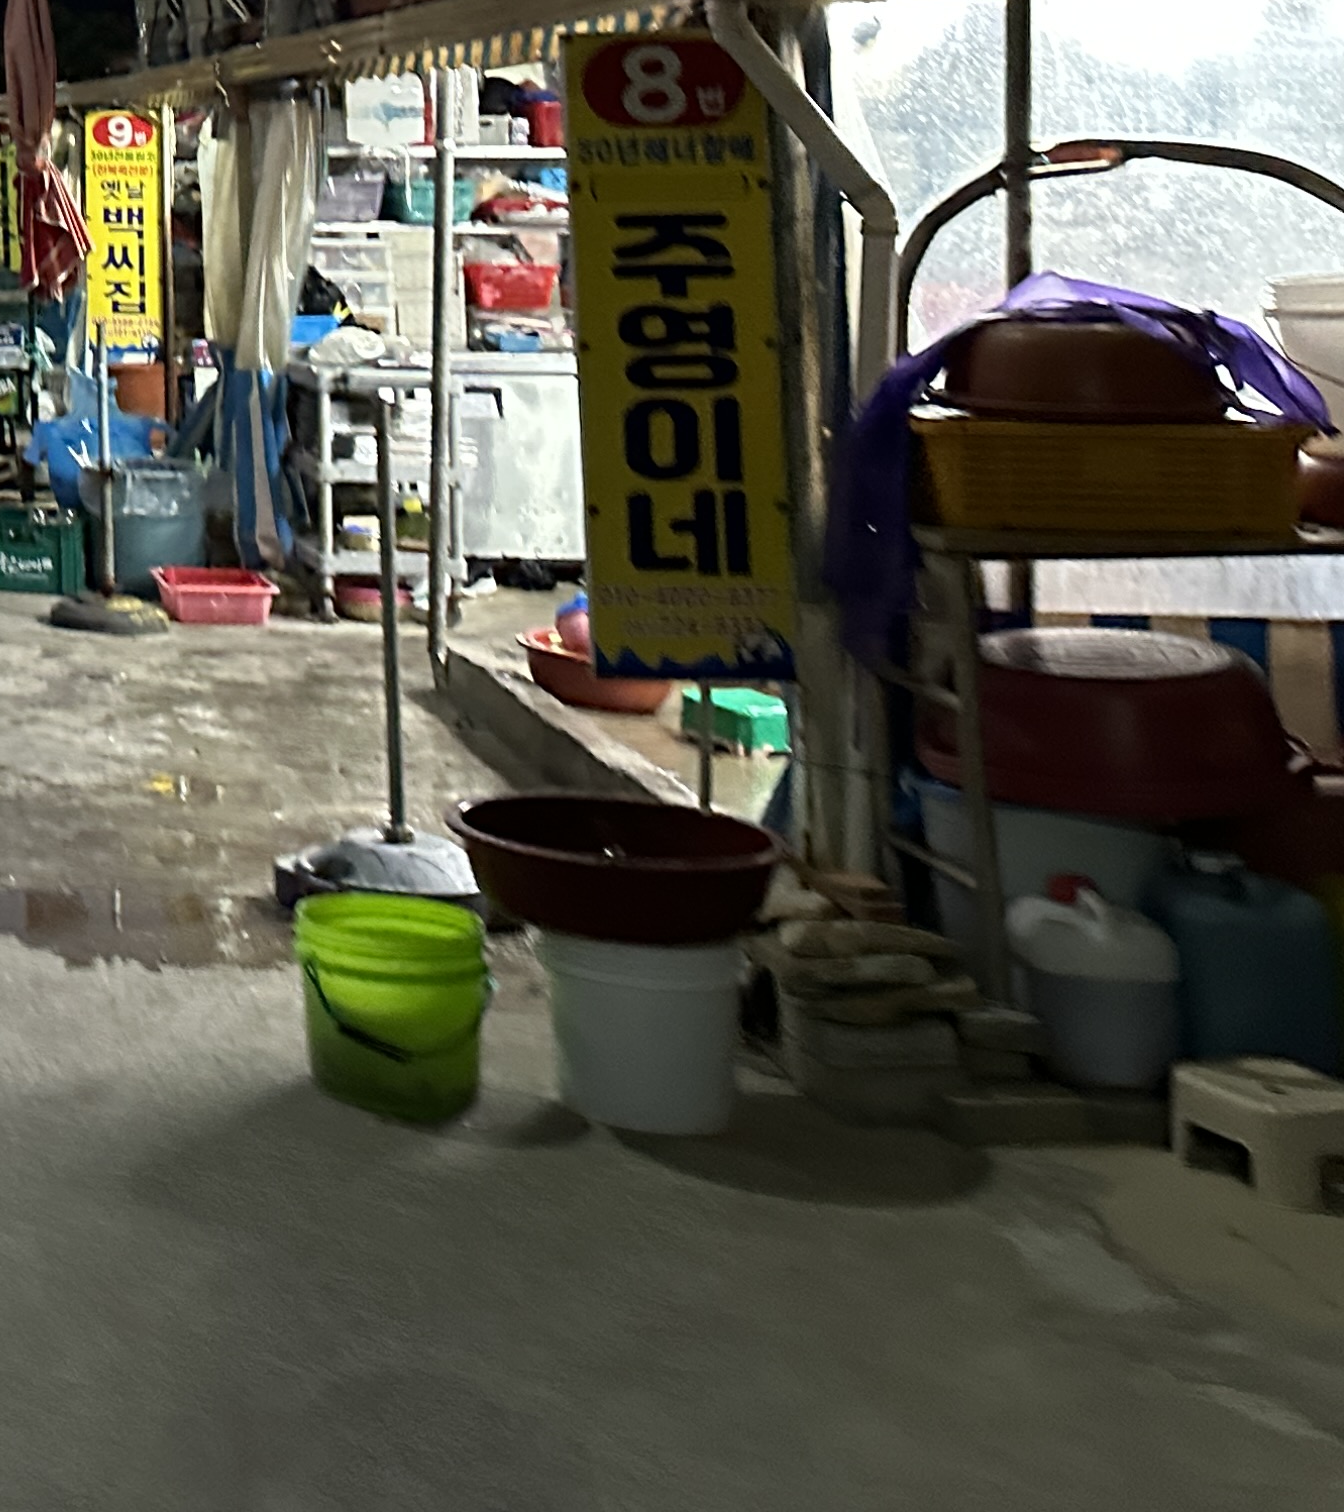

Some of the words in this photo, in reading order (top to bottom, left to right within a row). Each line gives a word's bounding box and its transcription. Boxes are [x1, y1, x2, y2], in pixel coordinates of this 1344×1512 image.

[101, 180, 146, 201] 옛날
[102, 206, 146, 314] 백씨집
[610, 213, 751, 578] 주영이네
